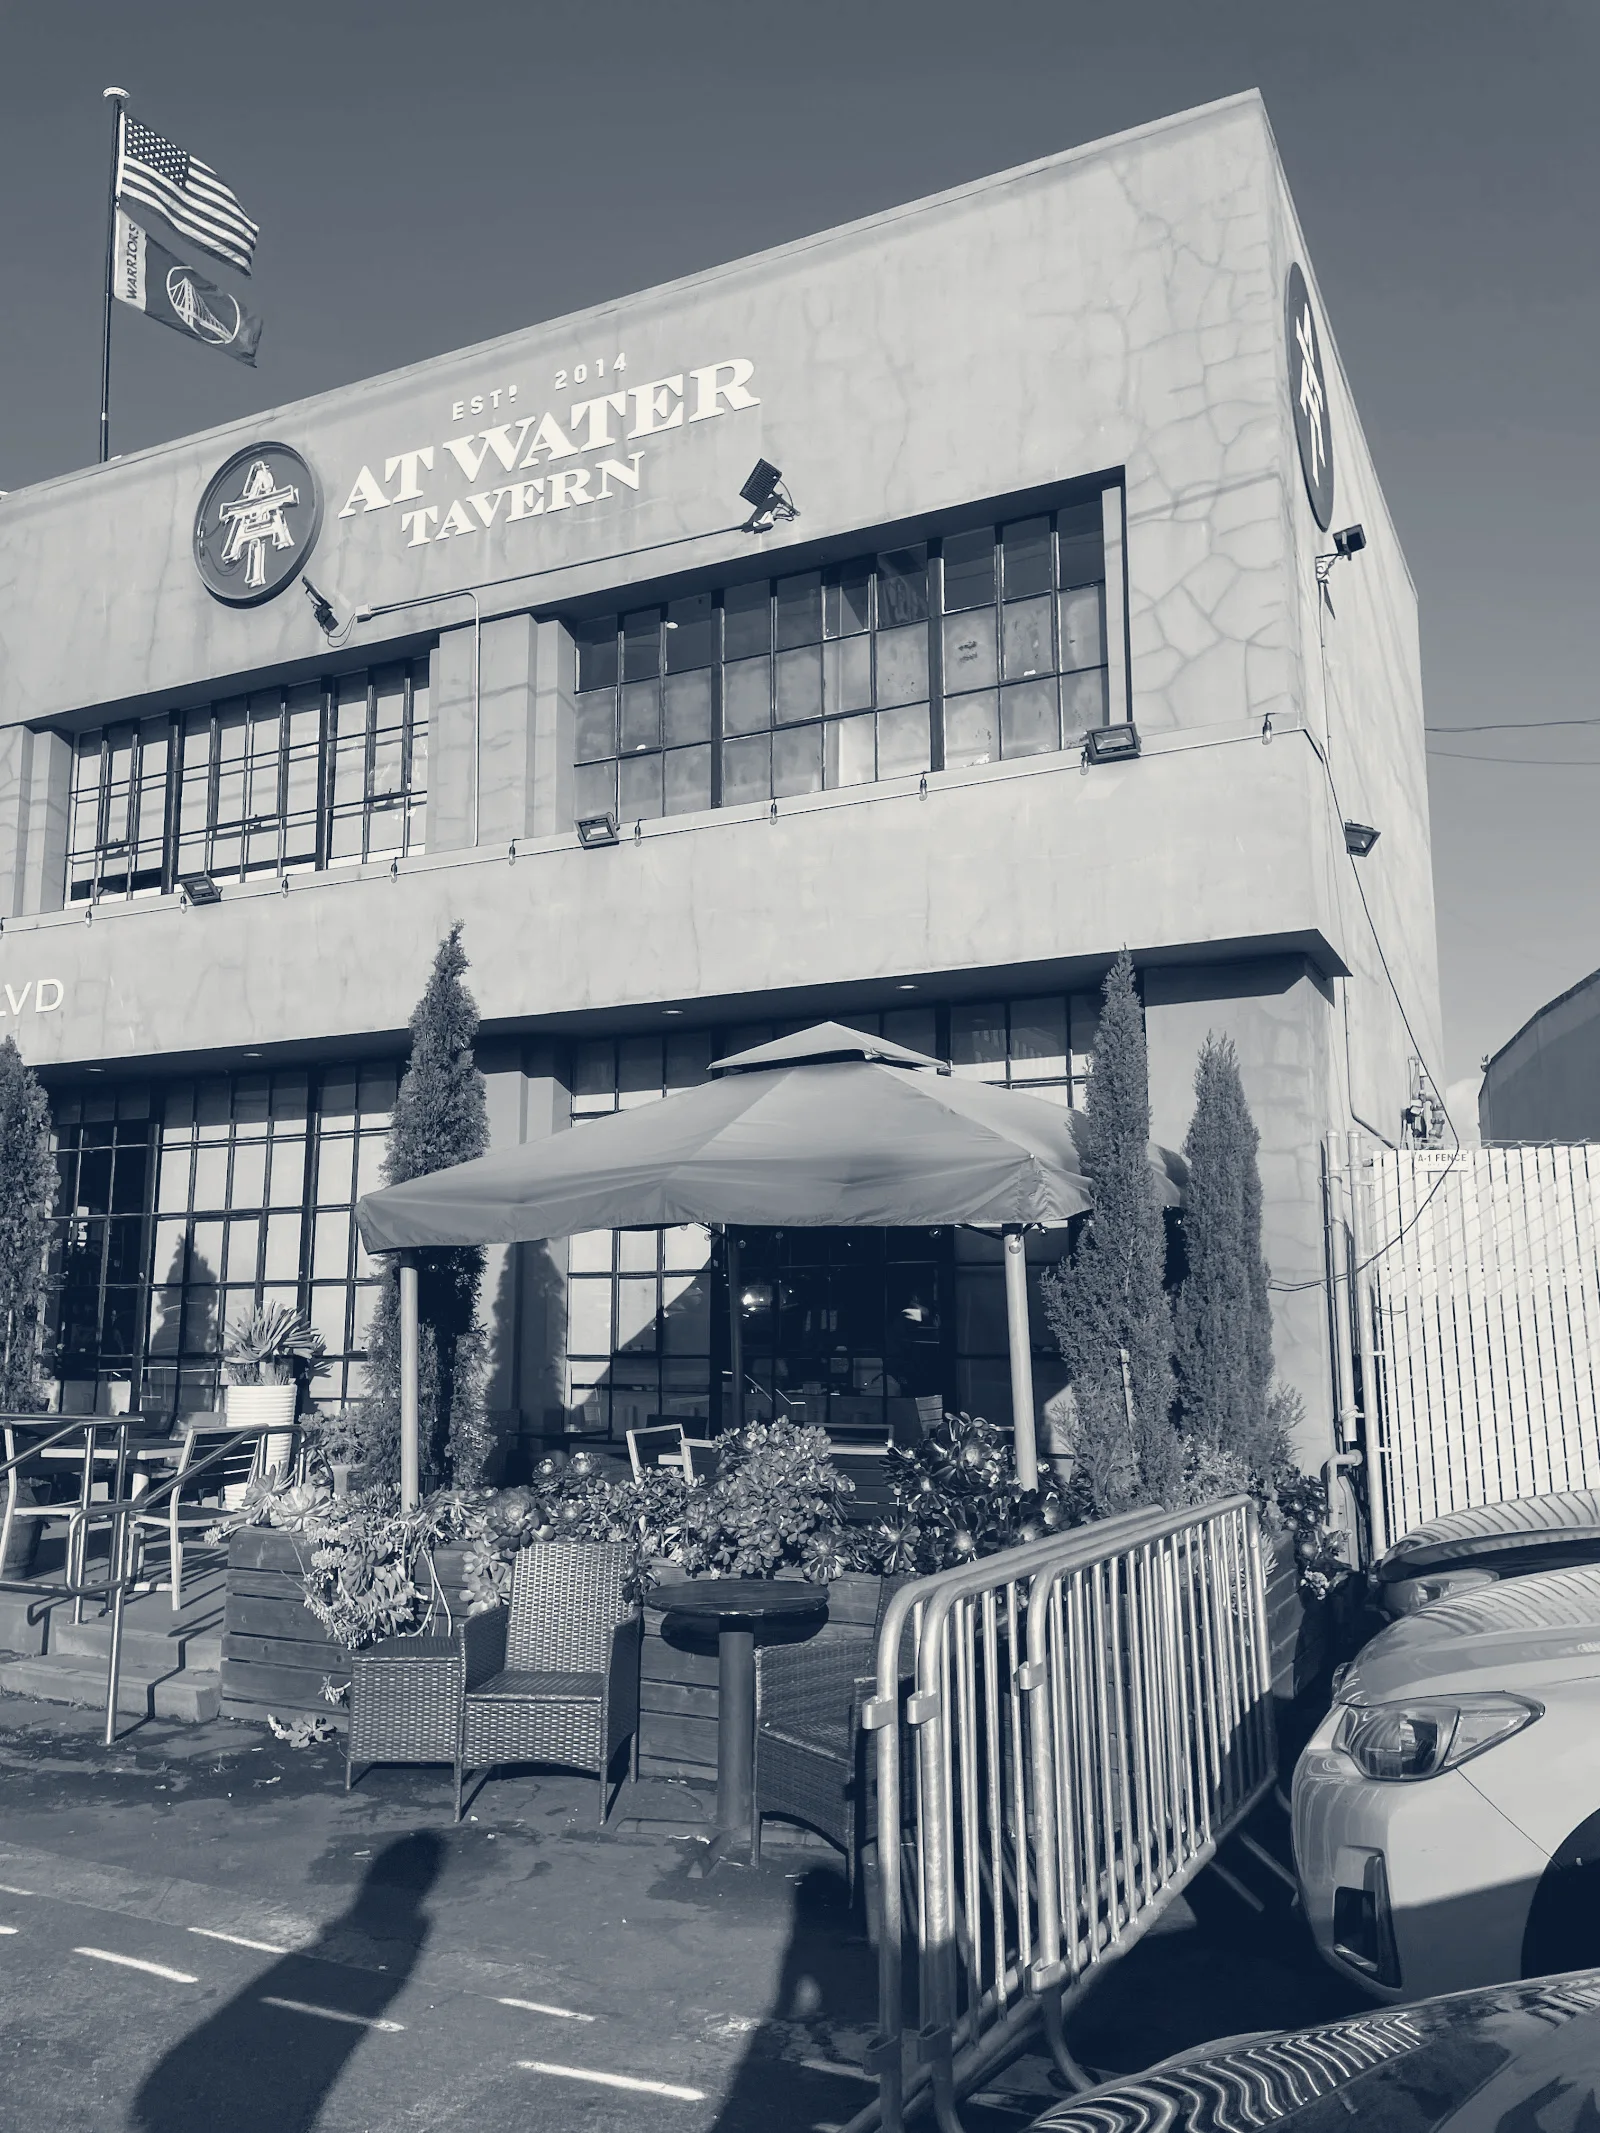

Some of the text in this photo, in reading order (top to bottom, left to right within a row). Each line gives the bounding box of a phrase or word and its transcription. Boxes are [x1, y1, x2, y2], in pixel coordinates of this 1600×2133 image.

[126, 223, 139, 299] WARRIORS
[554, 352, 627, 390] 2014
[401, 450, 645, 548] TAVERN
[1435, 1153, 1467, 1162] FENCE
